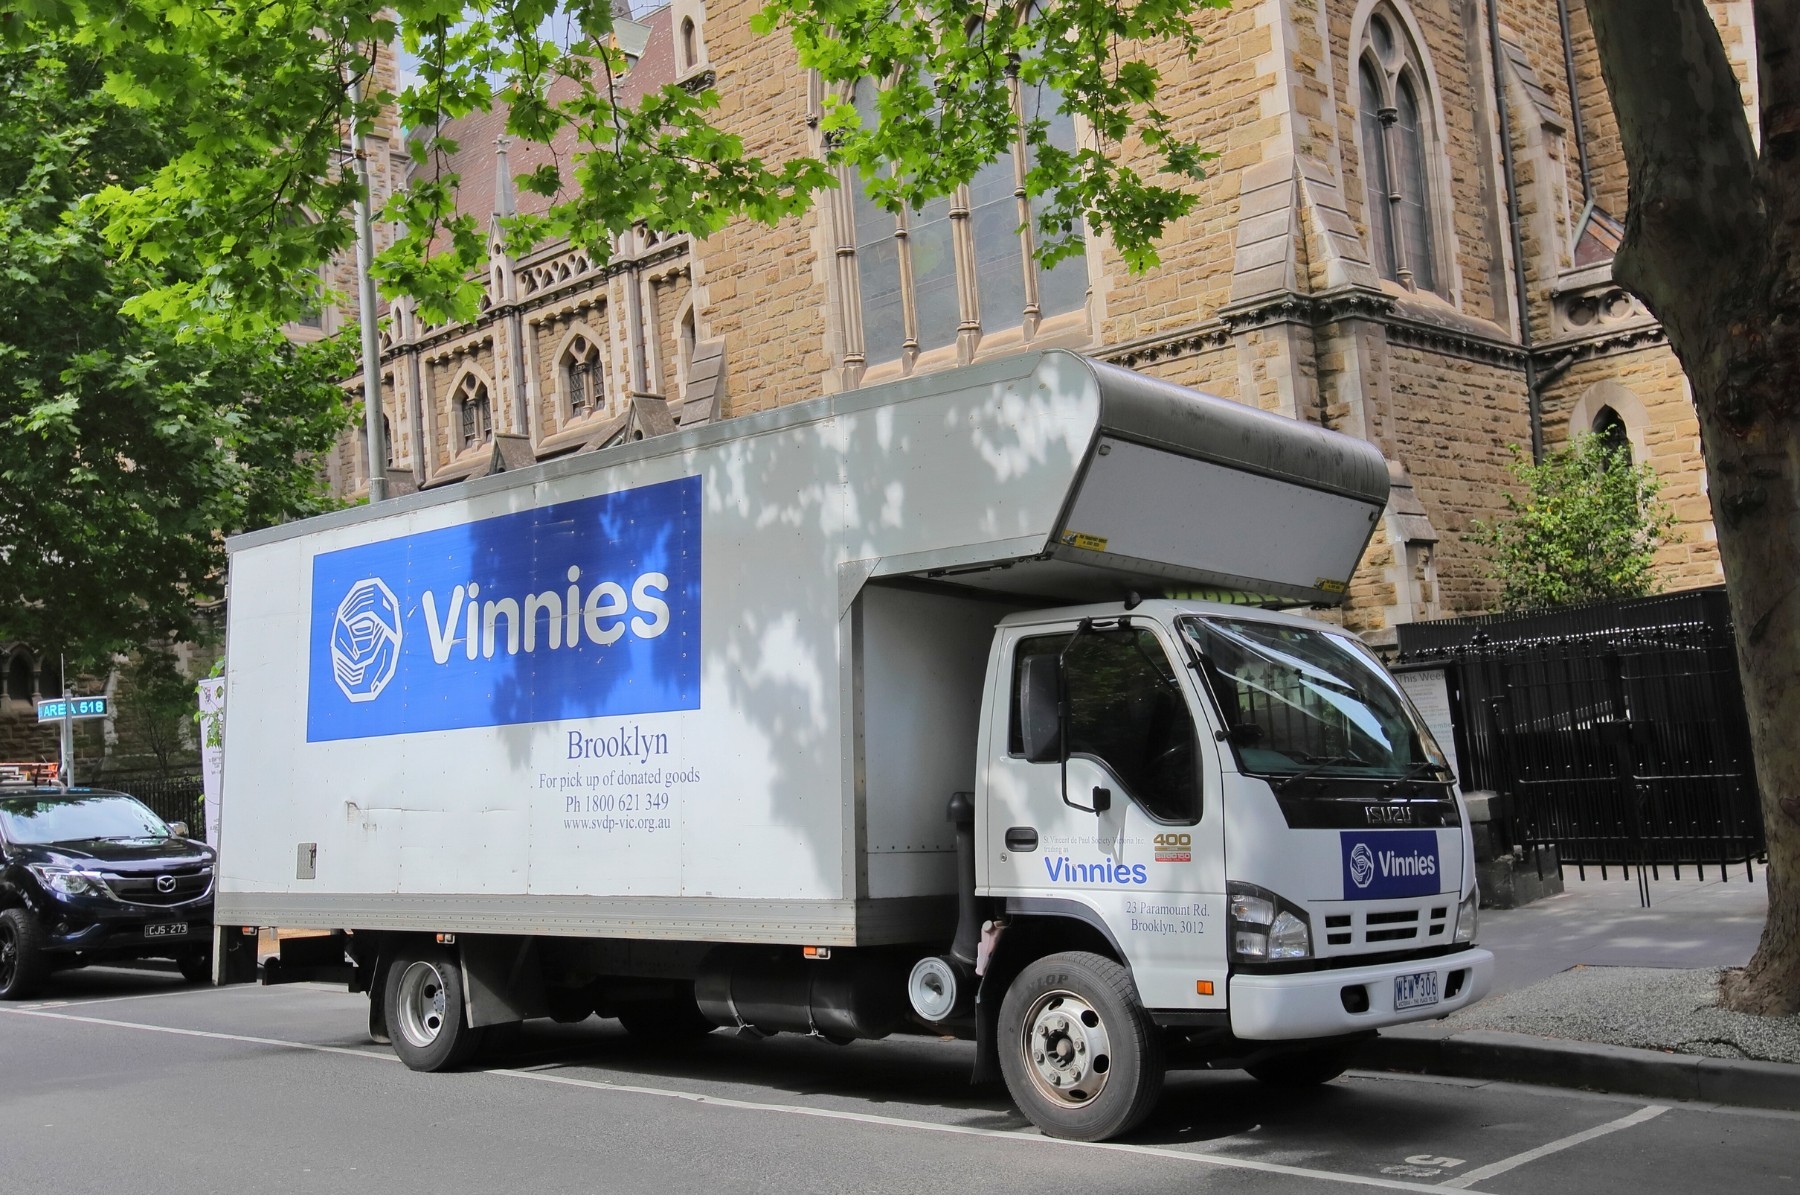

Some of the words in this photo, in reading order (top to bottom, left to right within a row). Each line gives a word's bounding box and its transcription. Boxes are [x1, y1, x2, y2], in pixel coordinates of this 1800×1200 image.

[422, 564, 670, 664] Vinnies
[1398, 674, 1417, 683] This
[80, 700, 104, 714] 518
[566, 725, 669, 764] Brooklyn
[539, 772, 559, 788] For
[560, 772, 582, 791] pick
[587, 775, 600, 791] up
[603, 770, 616, 786] of
[618, 769, 661, 786] donated
[665, 767, 700, 788] goods
[566, 795, 580, 812] Ph
[586, 794, 614, 812] 1800
[618, 794, 640, 811] 621
[645, 792, 669, 811] 349
[564, 815, 671, 833] www.svdp-vic.org.au
[1365, 806, 1411, 824] ISUZU
[1153, 834, 1191, 846] 400
[1044, 856, 1148, 884] Vinnies
[1378, 850, 1435, 878] Vinnies
[1126, 901, 1137, 914] 23
[1140, 901, 1190, 916] Paramount
[1193, 906, 1210, 917] Rd.
[1131, 918, 1177, 935] Brooklyn,
[1180, 922, 1204, 934] 3012
[1397, 980, 1414, 1000] WEW
[1421, 976, 1436, 997] 306
